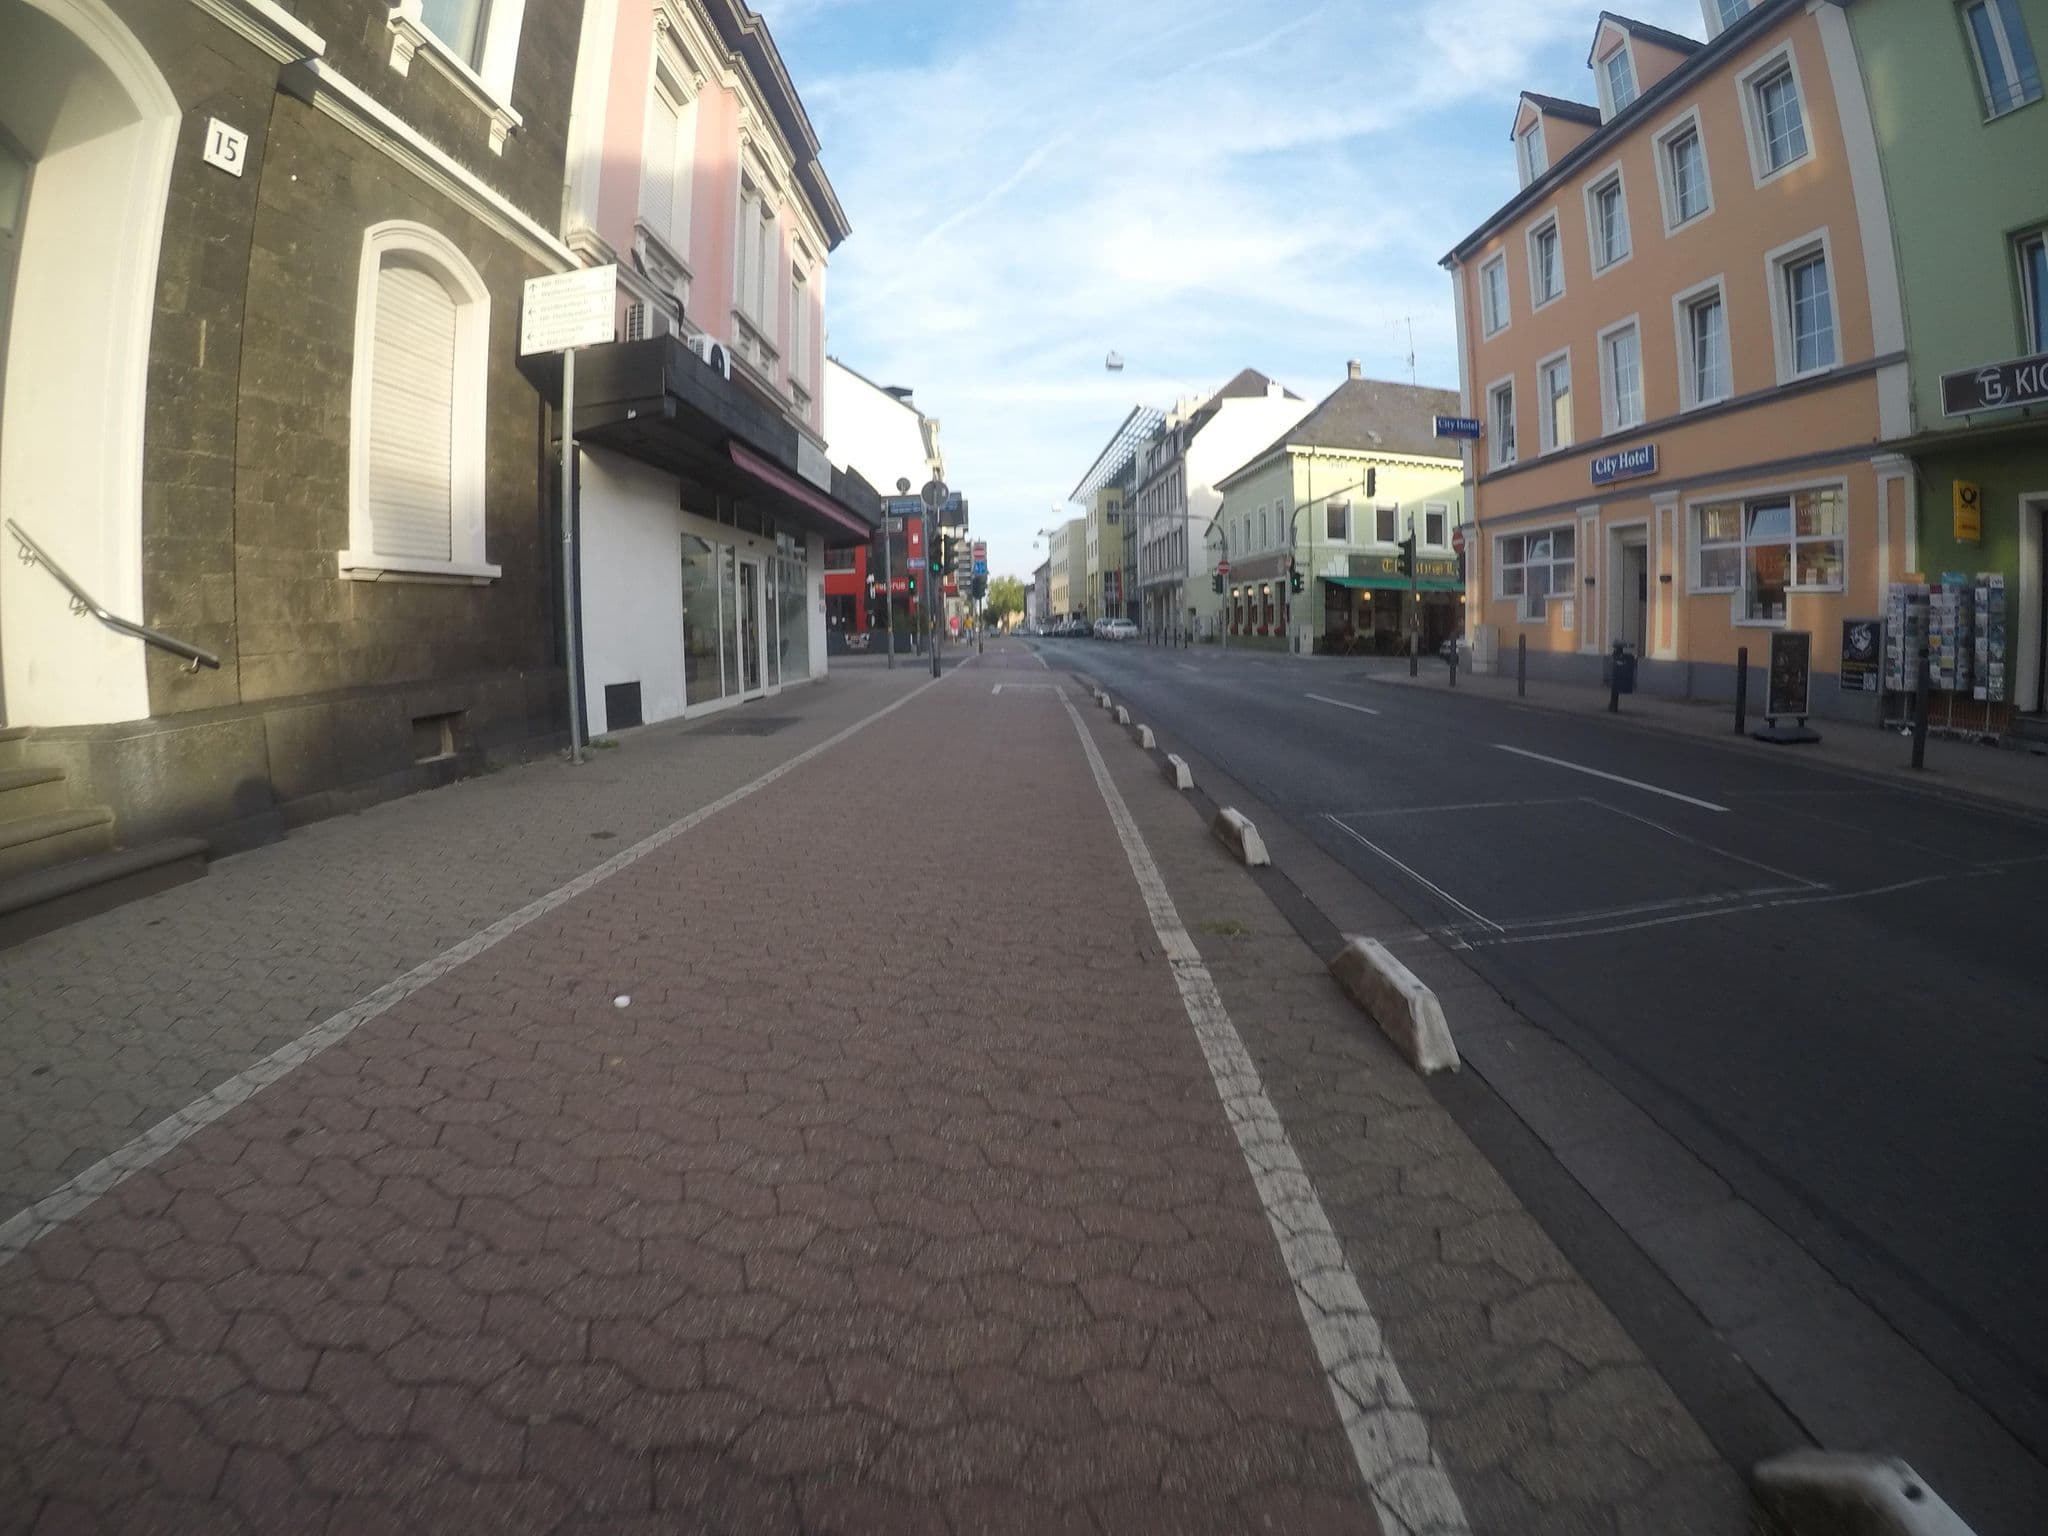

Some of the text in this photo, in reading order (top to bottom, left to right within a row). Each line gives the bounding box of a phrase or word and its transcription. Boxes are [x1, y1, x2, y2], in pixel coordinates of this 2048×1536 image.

[216, 130, 239, 162] 15
[1438, 418, 1455, 431] City
[1595, 446, 1648, 476] City Hotel
